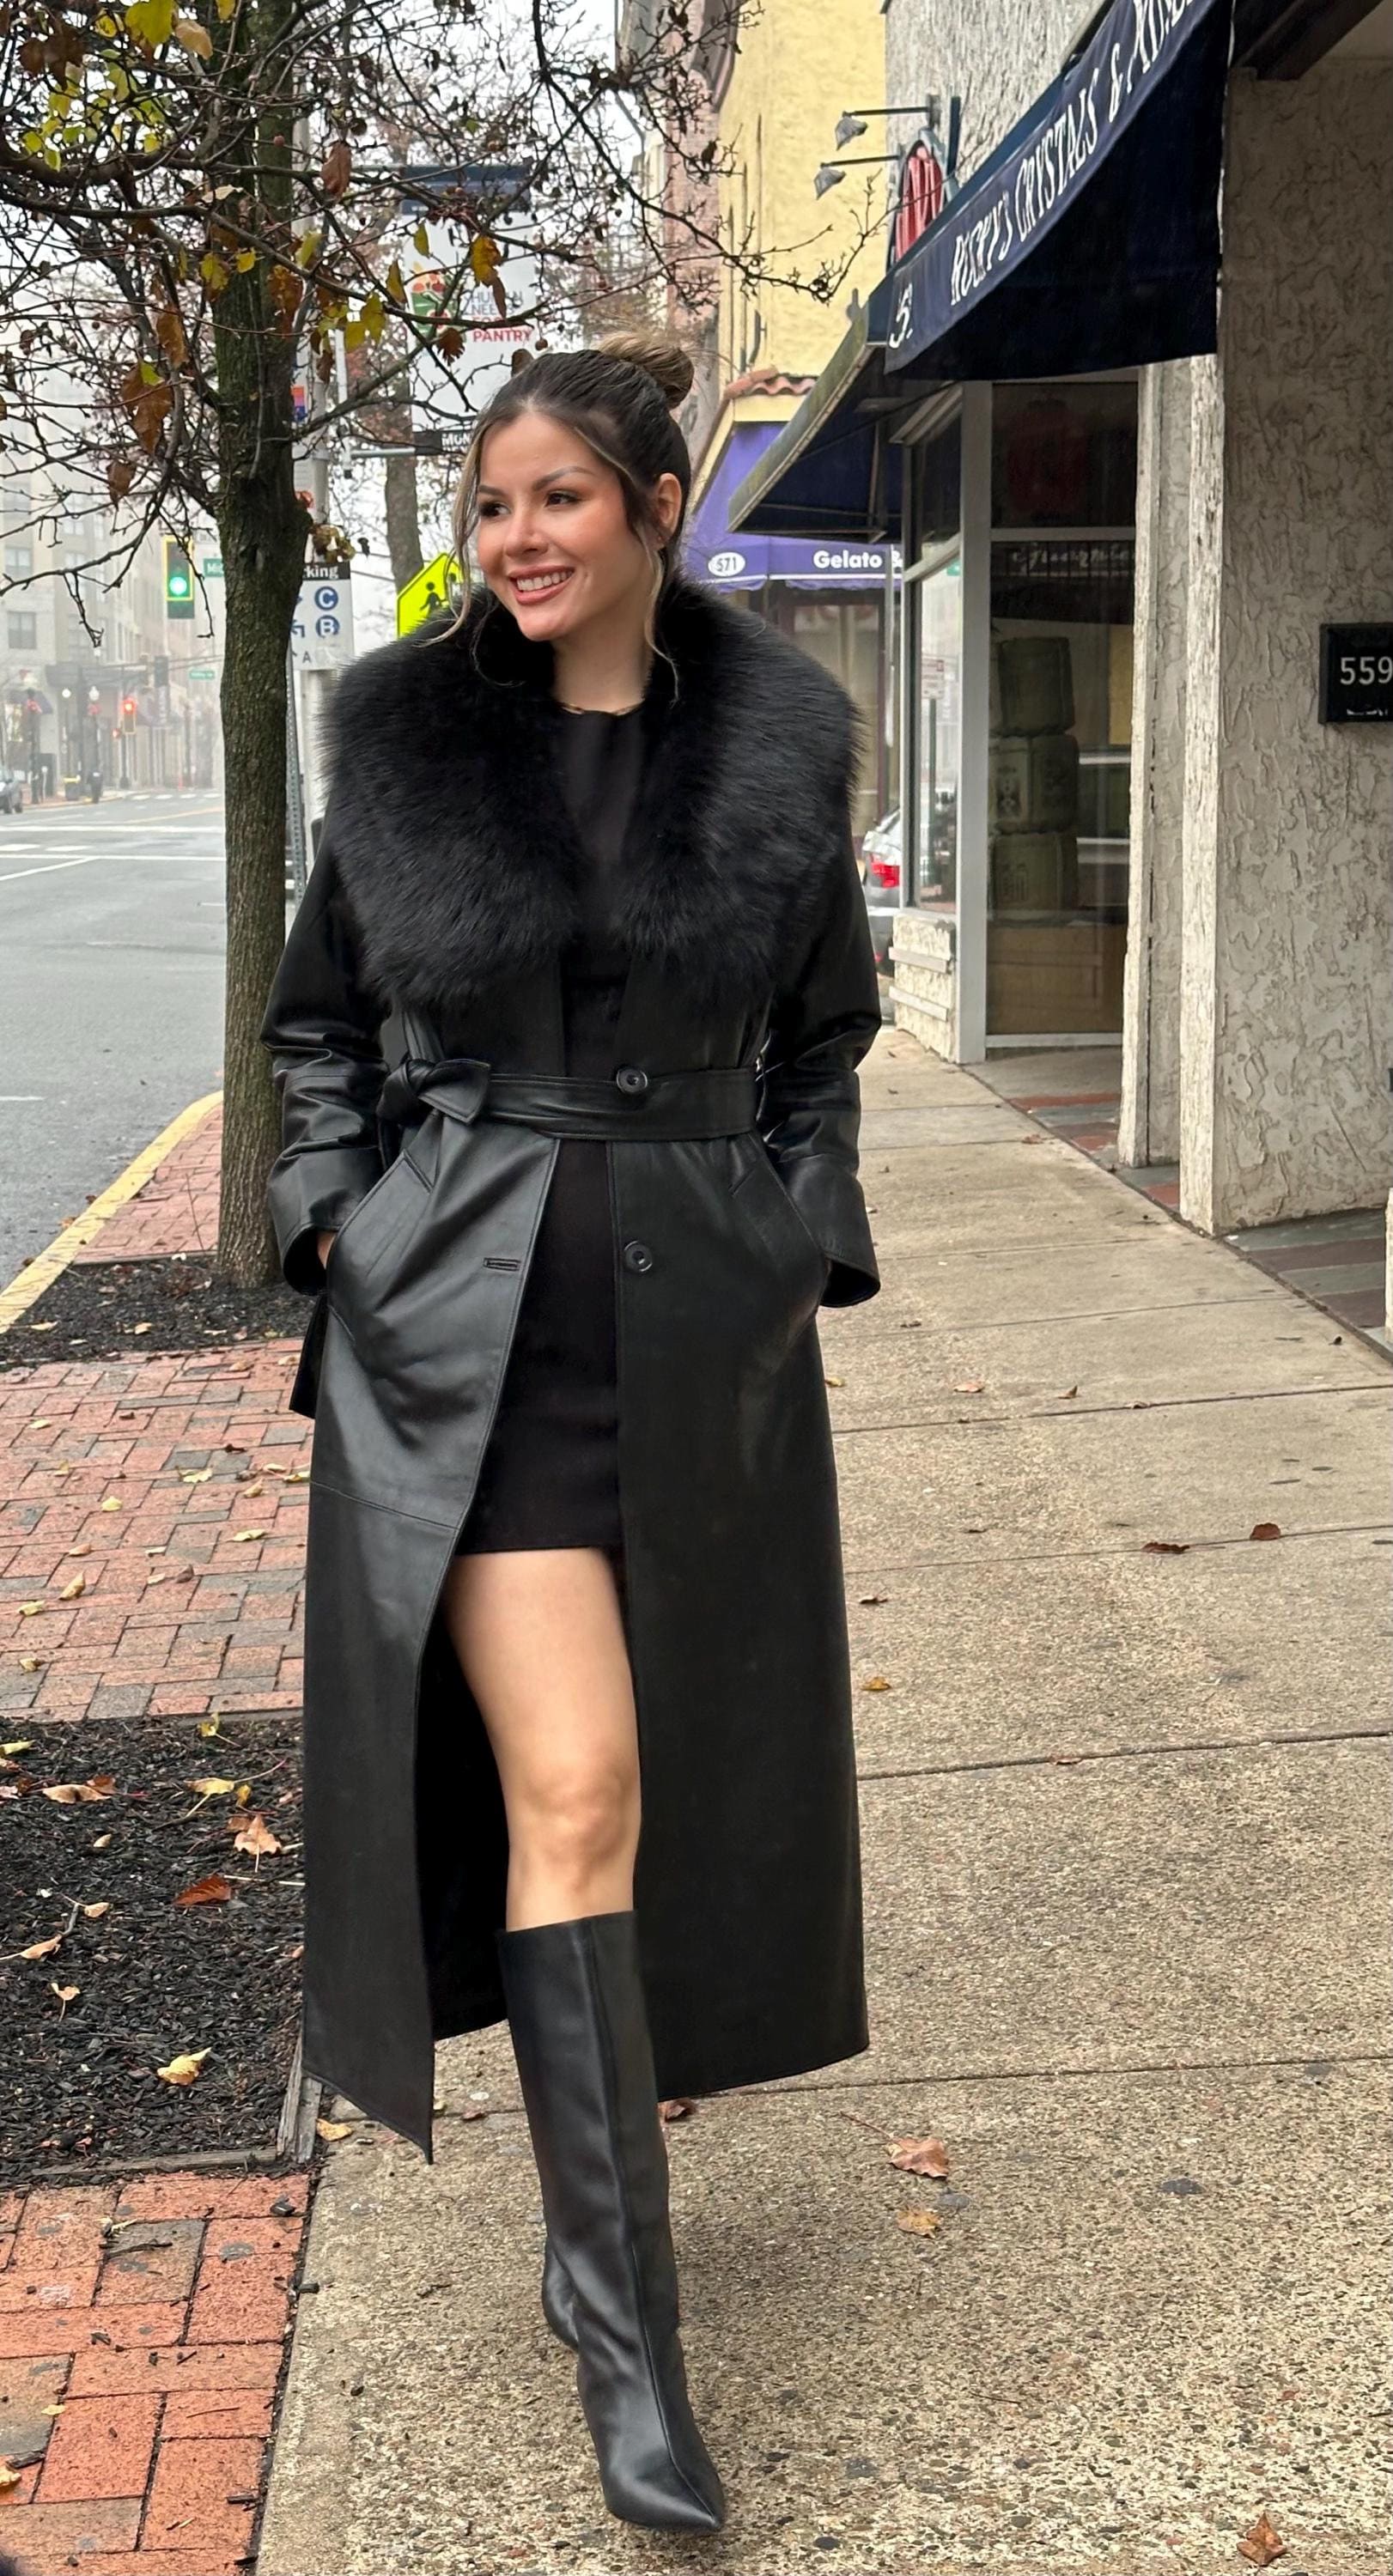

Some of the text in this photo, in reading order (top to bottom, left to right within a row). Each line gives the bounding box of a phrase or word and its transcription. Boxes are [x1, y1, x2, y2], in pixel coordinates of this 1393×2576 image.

[1013, 67, 1101, 243] CRYSTALS
[471, 304, 514, 315] NEES
[472, 329, 532, 343] PANTRY
[714, 556, 737, 573] 571
[813, 550, 883, 568] Gelato
[319, 589, 334, 608] C
[1340, 656, 1393, 685] 559
